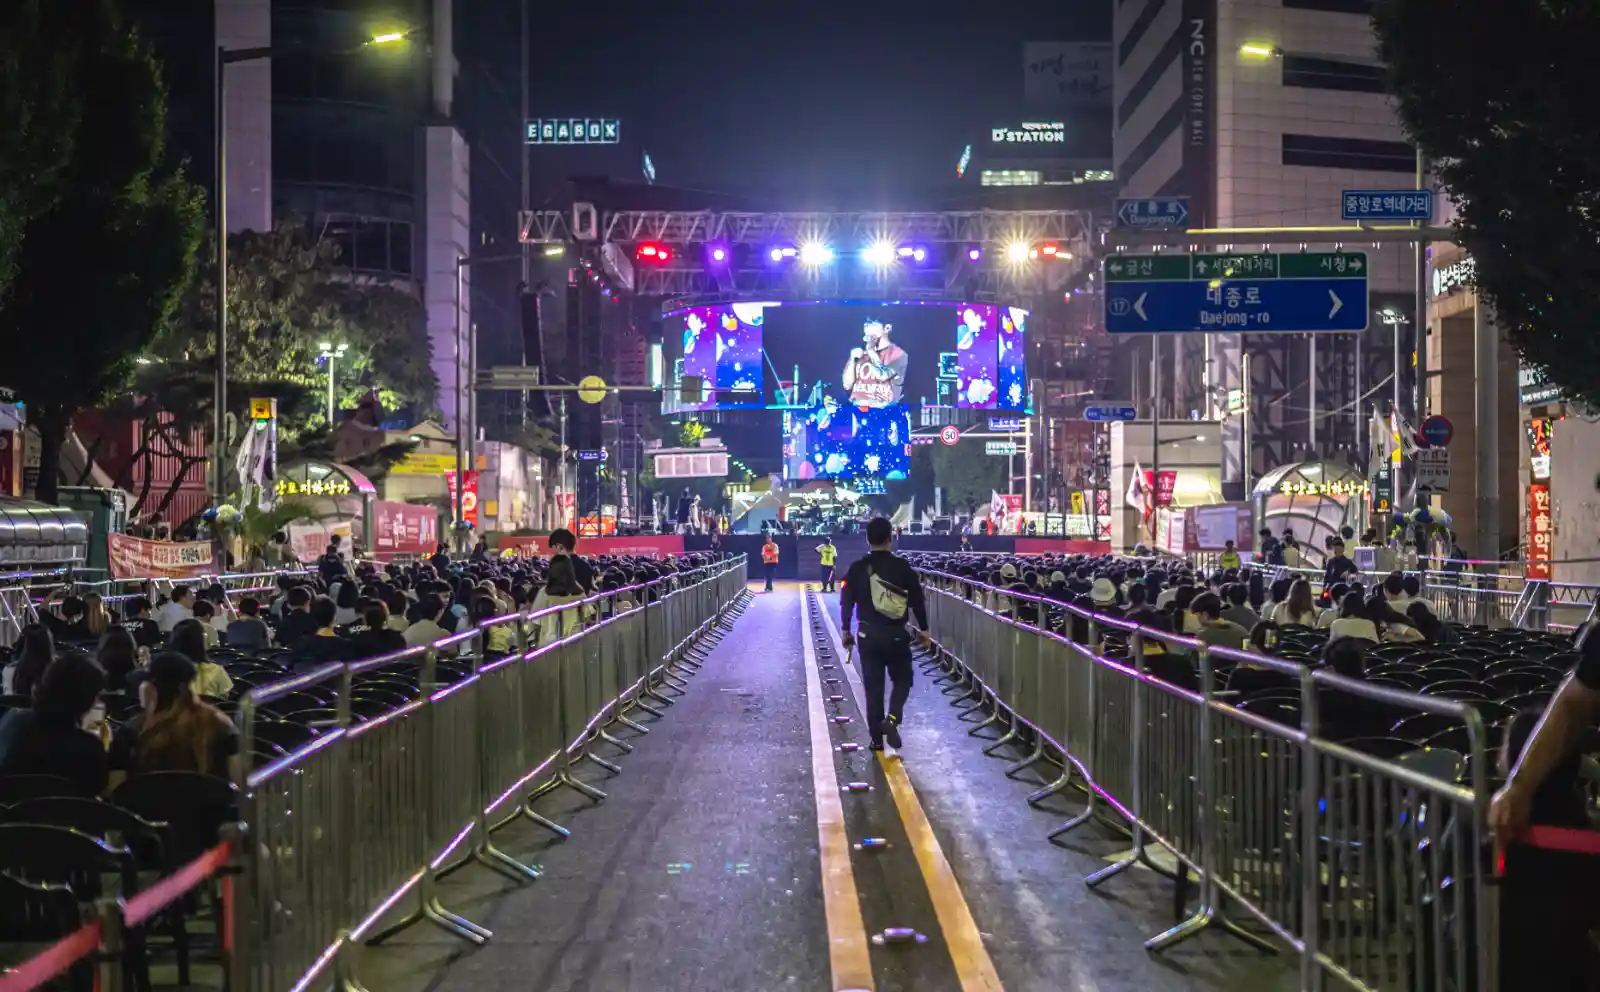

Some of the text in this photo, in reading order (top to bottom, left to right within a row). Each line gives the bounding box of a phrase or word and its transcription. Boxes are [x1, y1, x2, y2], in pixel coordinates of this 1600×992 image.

[1190, 18, 1205, 56] NC
[1346, 195, 1428, 213] 중앙로역네거리
[1126, 260, 1153, 276] 금산
[1320, 256, 1346, 273] 시청
[1206, 285, 1262, 308] 대종로
[1112, 301, 1126, 313] 17
[944, 431, 956, 440] 50
[1534, 490, 1550, 574] 한솔약국
